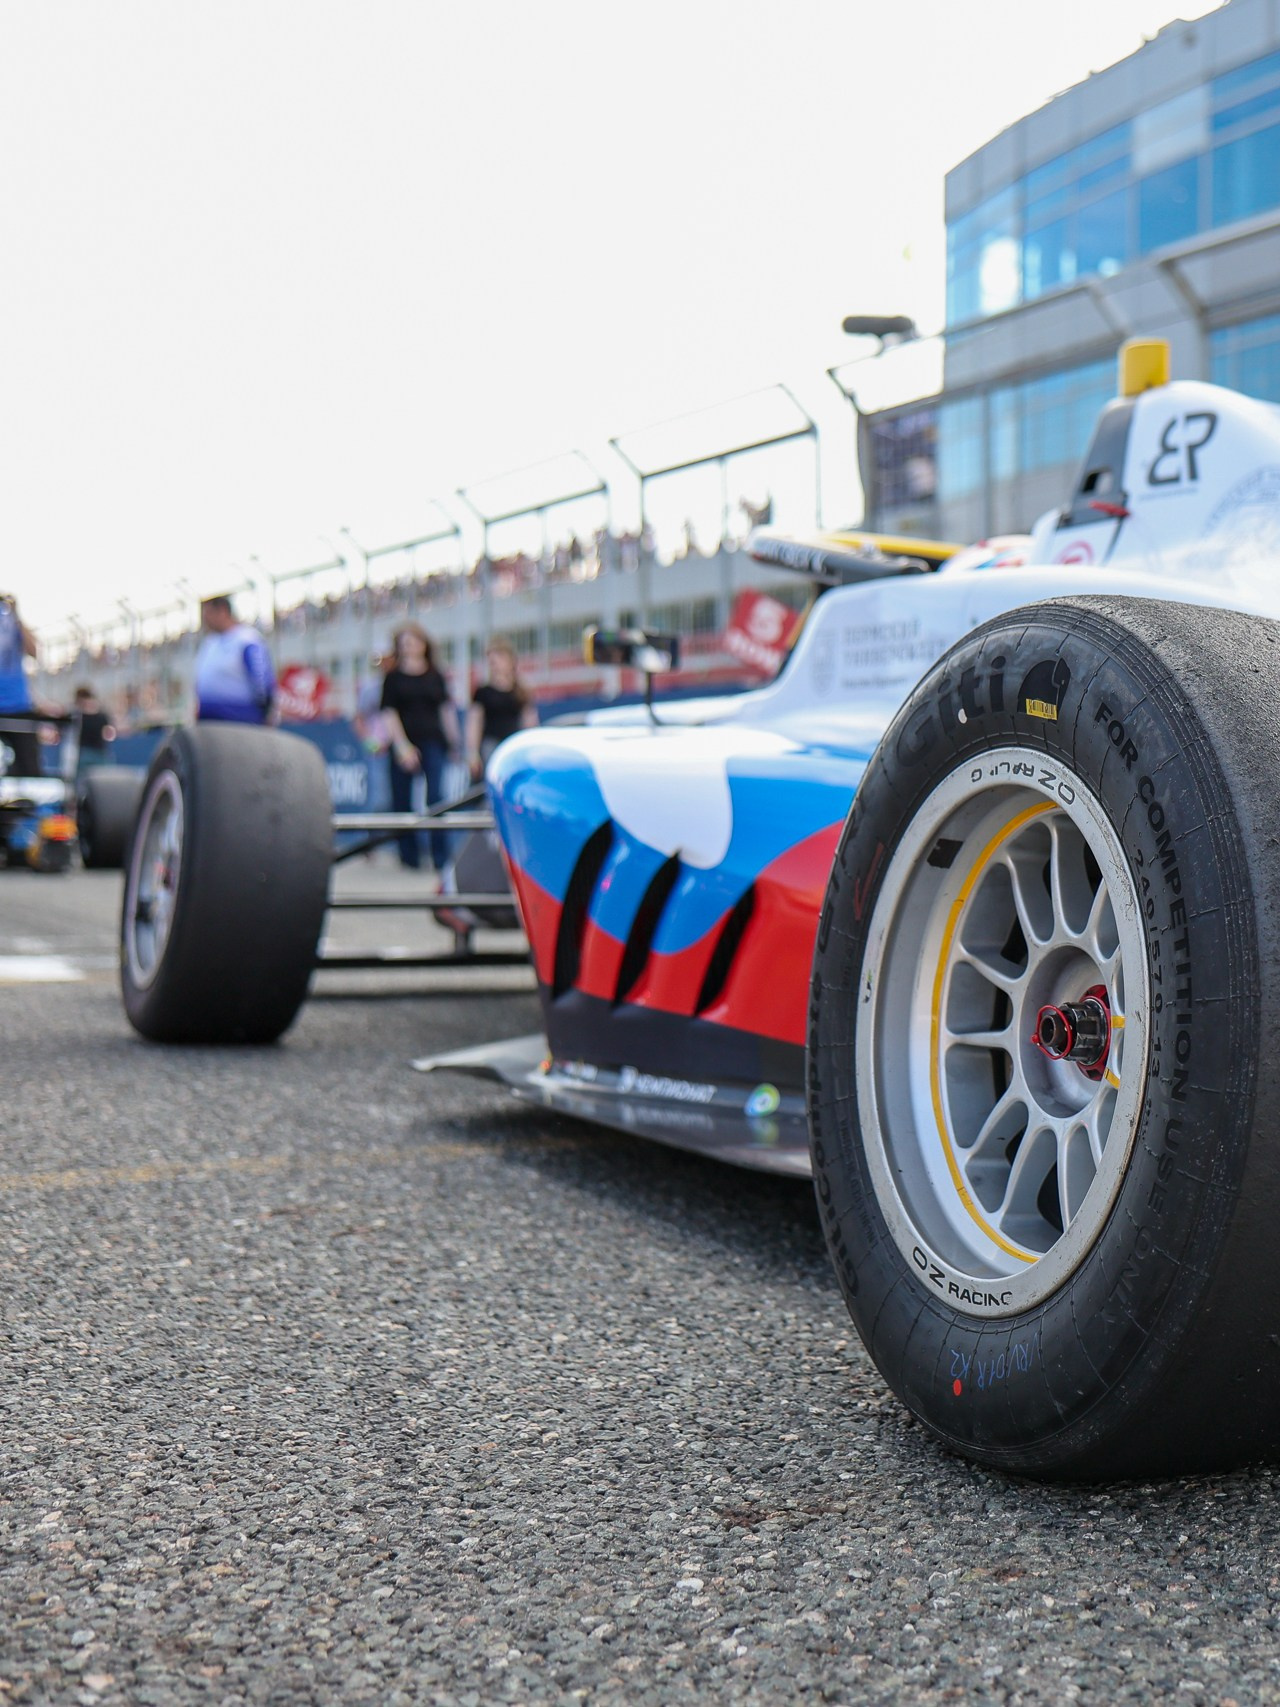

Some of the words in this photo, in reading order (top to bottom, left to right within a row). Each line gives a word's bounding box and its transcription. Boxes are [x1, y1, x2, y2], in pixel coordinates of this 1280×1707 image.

[897, 655, 1007, 768] Giti
[1094, 702, 1139, 772] FOR
[1137, 775, 1192, 1101] COMPETITION
[1146, 1118, 1183, 1215] USE
